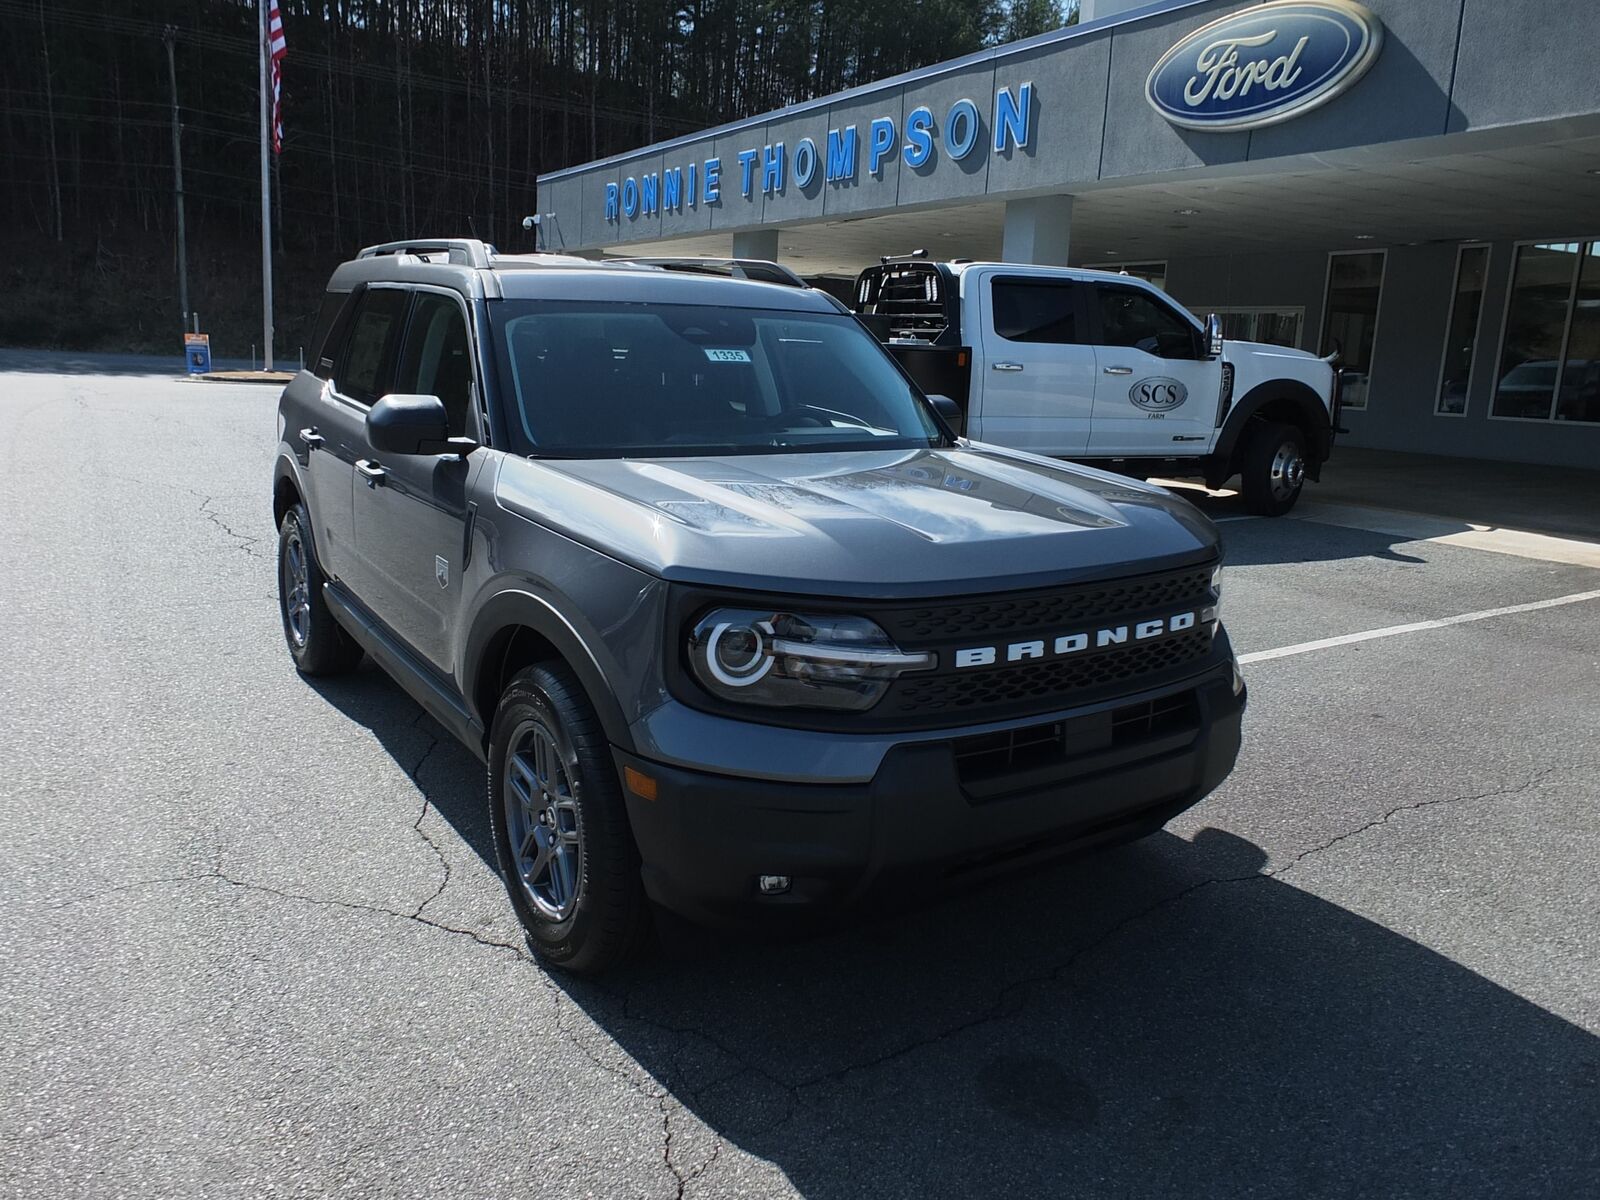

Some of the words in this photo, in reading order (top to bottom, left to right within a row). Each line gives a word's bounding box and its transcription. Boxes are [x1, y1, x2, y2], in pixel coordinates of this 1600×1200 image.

[1184, 30, 1309, 107] Ford
[605, 157, 720, 221] RONNIE
[738, 81, 1034, 197] THOMPSON
[712, 350, 744, 360] 1335
[1139, 384, 1177, 403] SCS
[955, 612, 1195, 668] BRONCO
